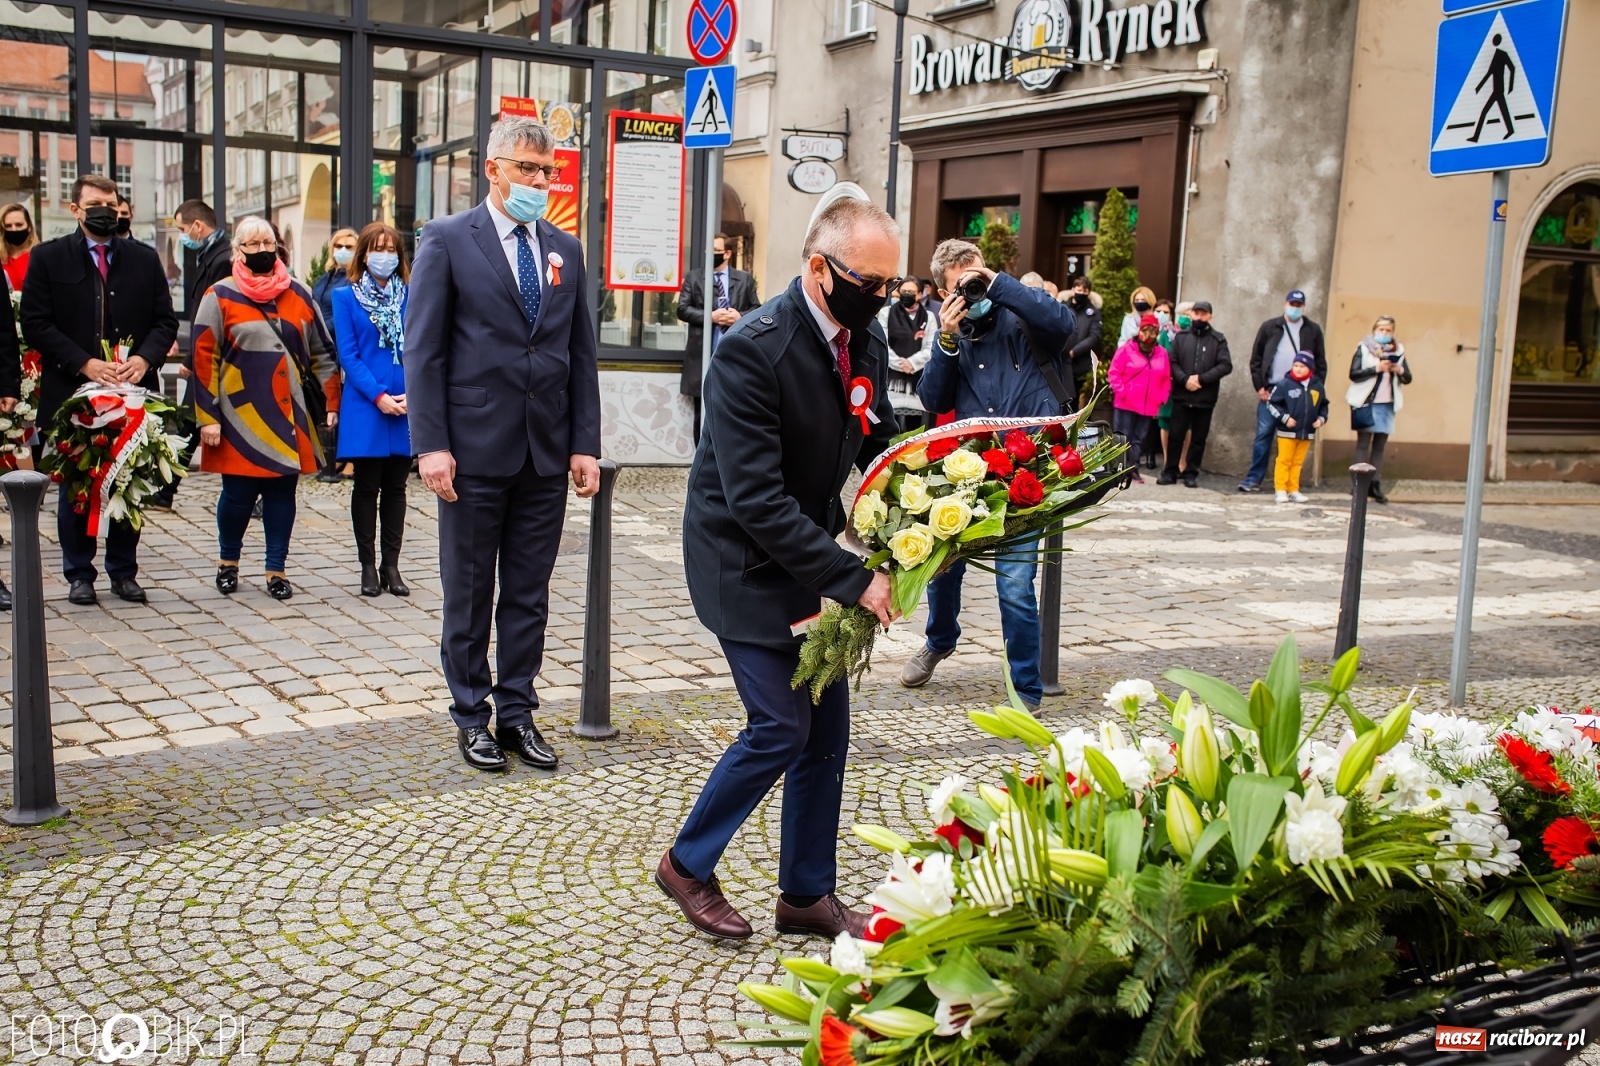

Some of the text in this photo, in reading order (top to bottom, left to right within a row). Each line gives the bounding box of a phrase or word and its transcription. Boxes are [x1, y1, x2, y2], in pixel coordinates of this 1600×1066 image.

[909, 0, 1201, 96] Browar Rynek
[624, 119, 675, 136] LUNCH
[799, 140, 832, 154] BUTIK
